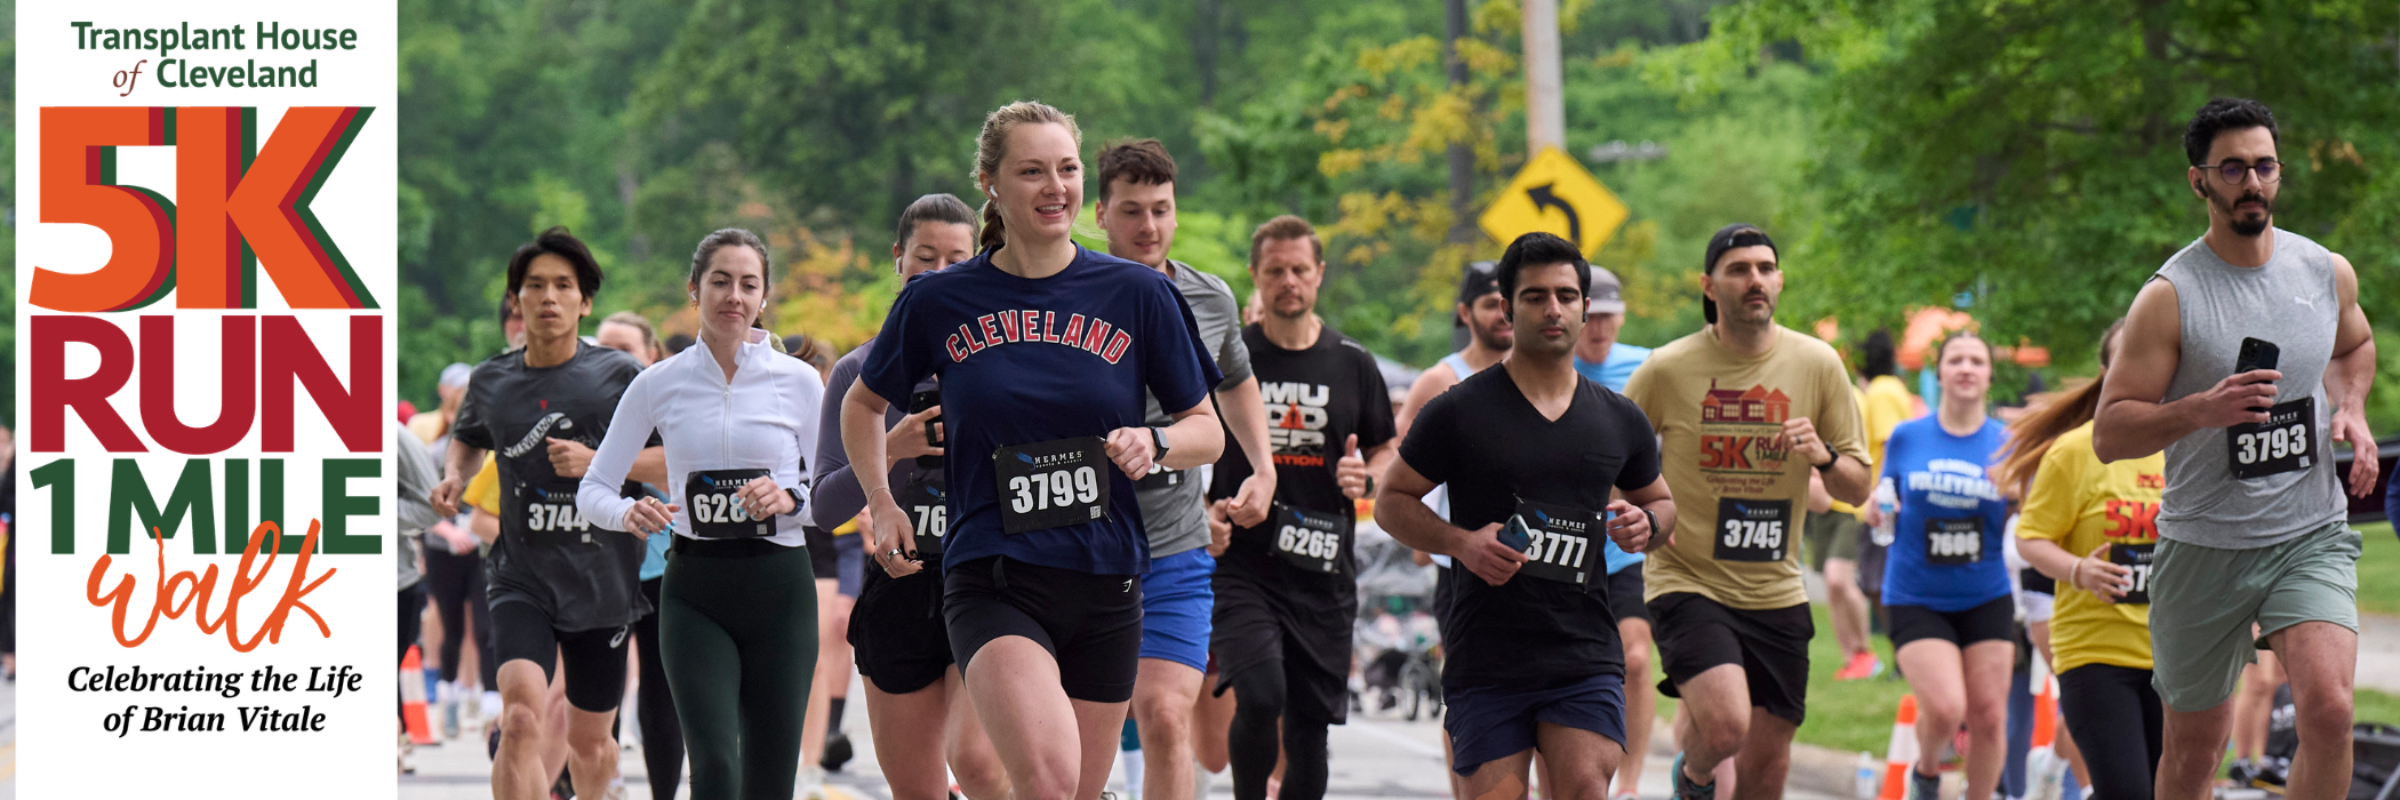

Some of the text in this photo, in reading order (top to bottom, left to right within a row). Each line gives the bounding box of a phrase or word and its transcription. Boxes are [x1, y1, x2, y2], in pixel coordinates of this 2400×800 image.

[946, 309, 1132, 365] CLEVELAND
[1035, 451, 1082, 465] HERMES
[1699, 435, 1754, 469] 5K
[2237, 423, 2306, 464] 3793
[1009, 465, 1098, 514] 3799
[528, 503, 590, 532] 3744
[693, 492, 764, 523] 628
[1548, 517, 1585, 530] HERMES
[1278, 524, 1339, 560] 6265
[1524, 528, 1588, 569] 3777
[1723, 518, 1782, 549] 3745
